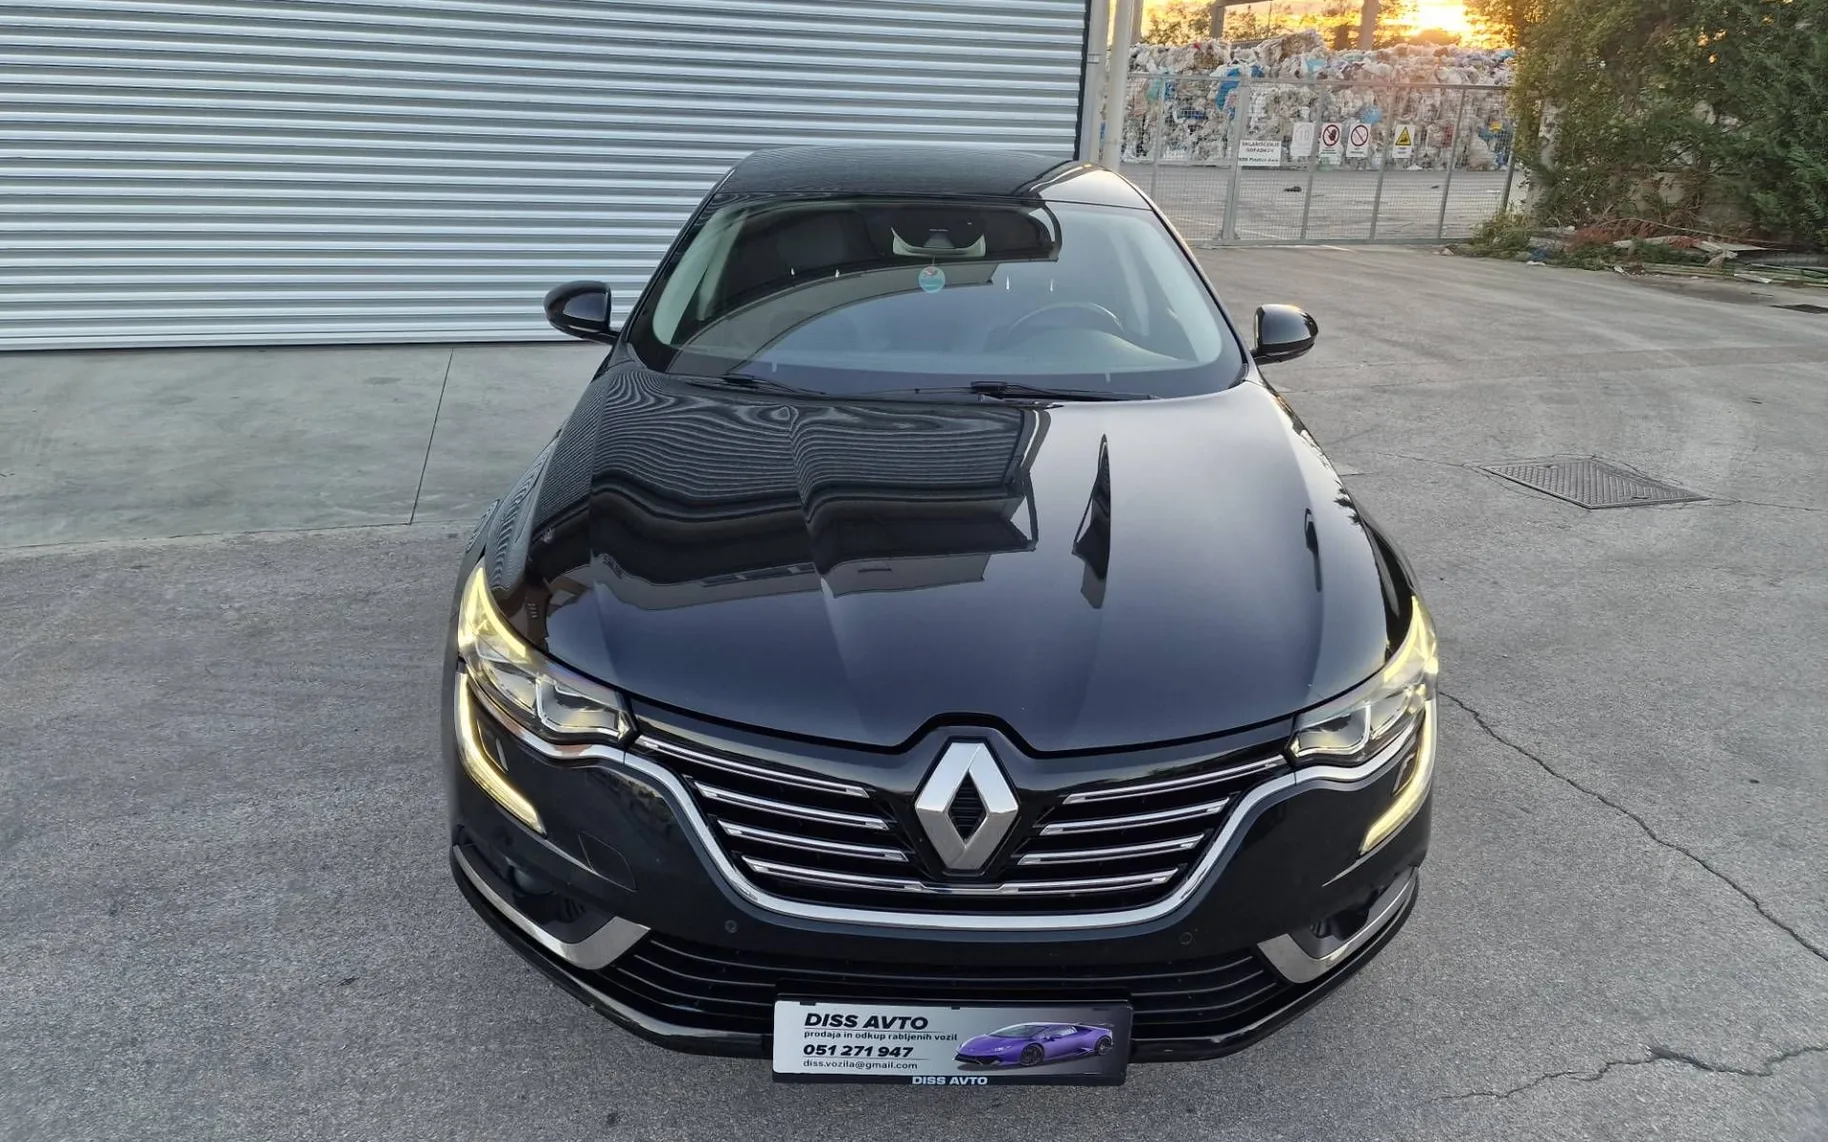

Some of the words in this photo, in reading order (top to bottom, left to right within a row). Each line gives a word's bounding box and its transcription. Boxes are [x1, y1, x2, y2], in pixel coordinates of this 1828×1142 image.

[804, 1013, 858, 1028] DISS
[862, 1015, 928, 1030] AVTO
[804, 1030, 841, 1039] prodaja
[844, 1031, 853, 1039] in
[855, 1032, 886, 1040] odkup
[888, 1033, 932, 1041] rabljenih
[803, 1044, 837, 1056] 051
[840, 1045, 873, 1057] 271
[877, 1046, 914, 1058] 947
[803, 1059, 918, 1070] diss.vozila@gmail.com
[912, 1076, 946, 1085] DISS
[948, 1076, 988, 1085] AVTO
